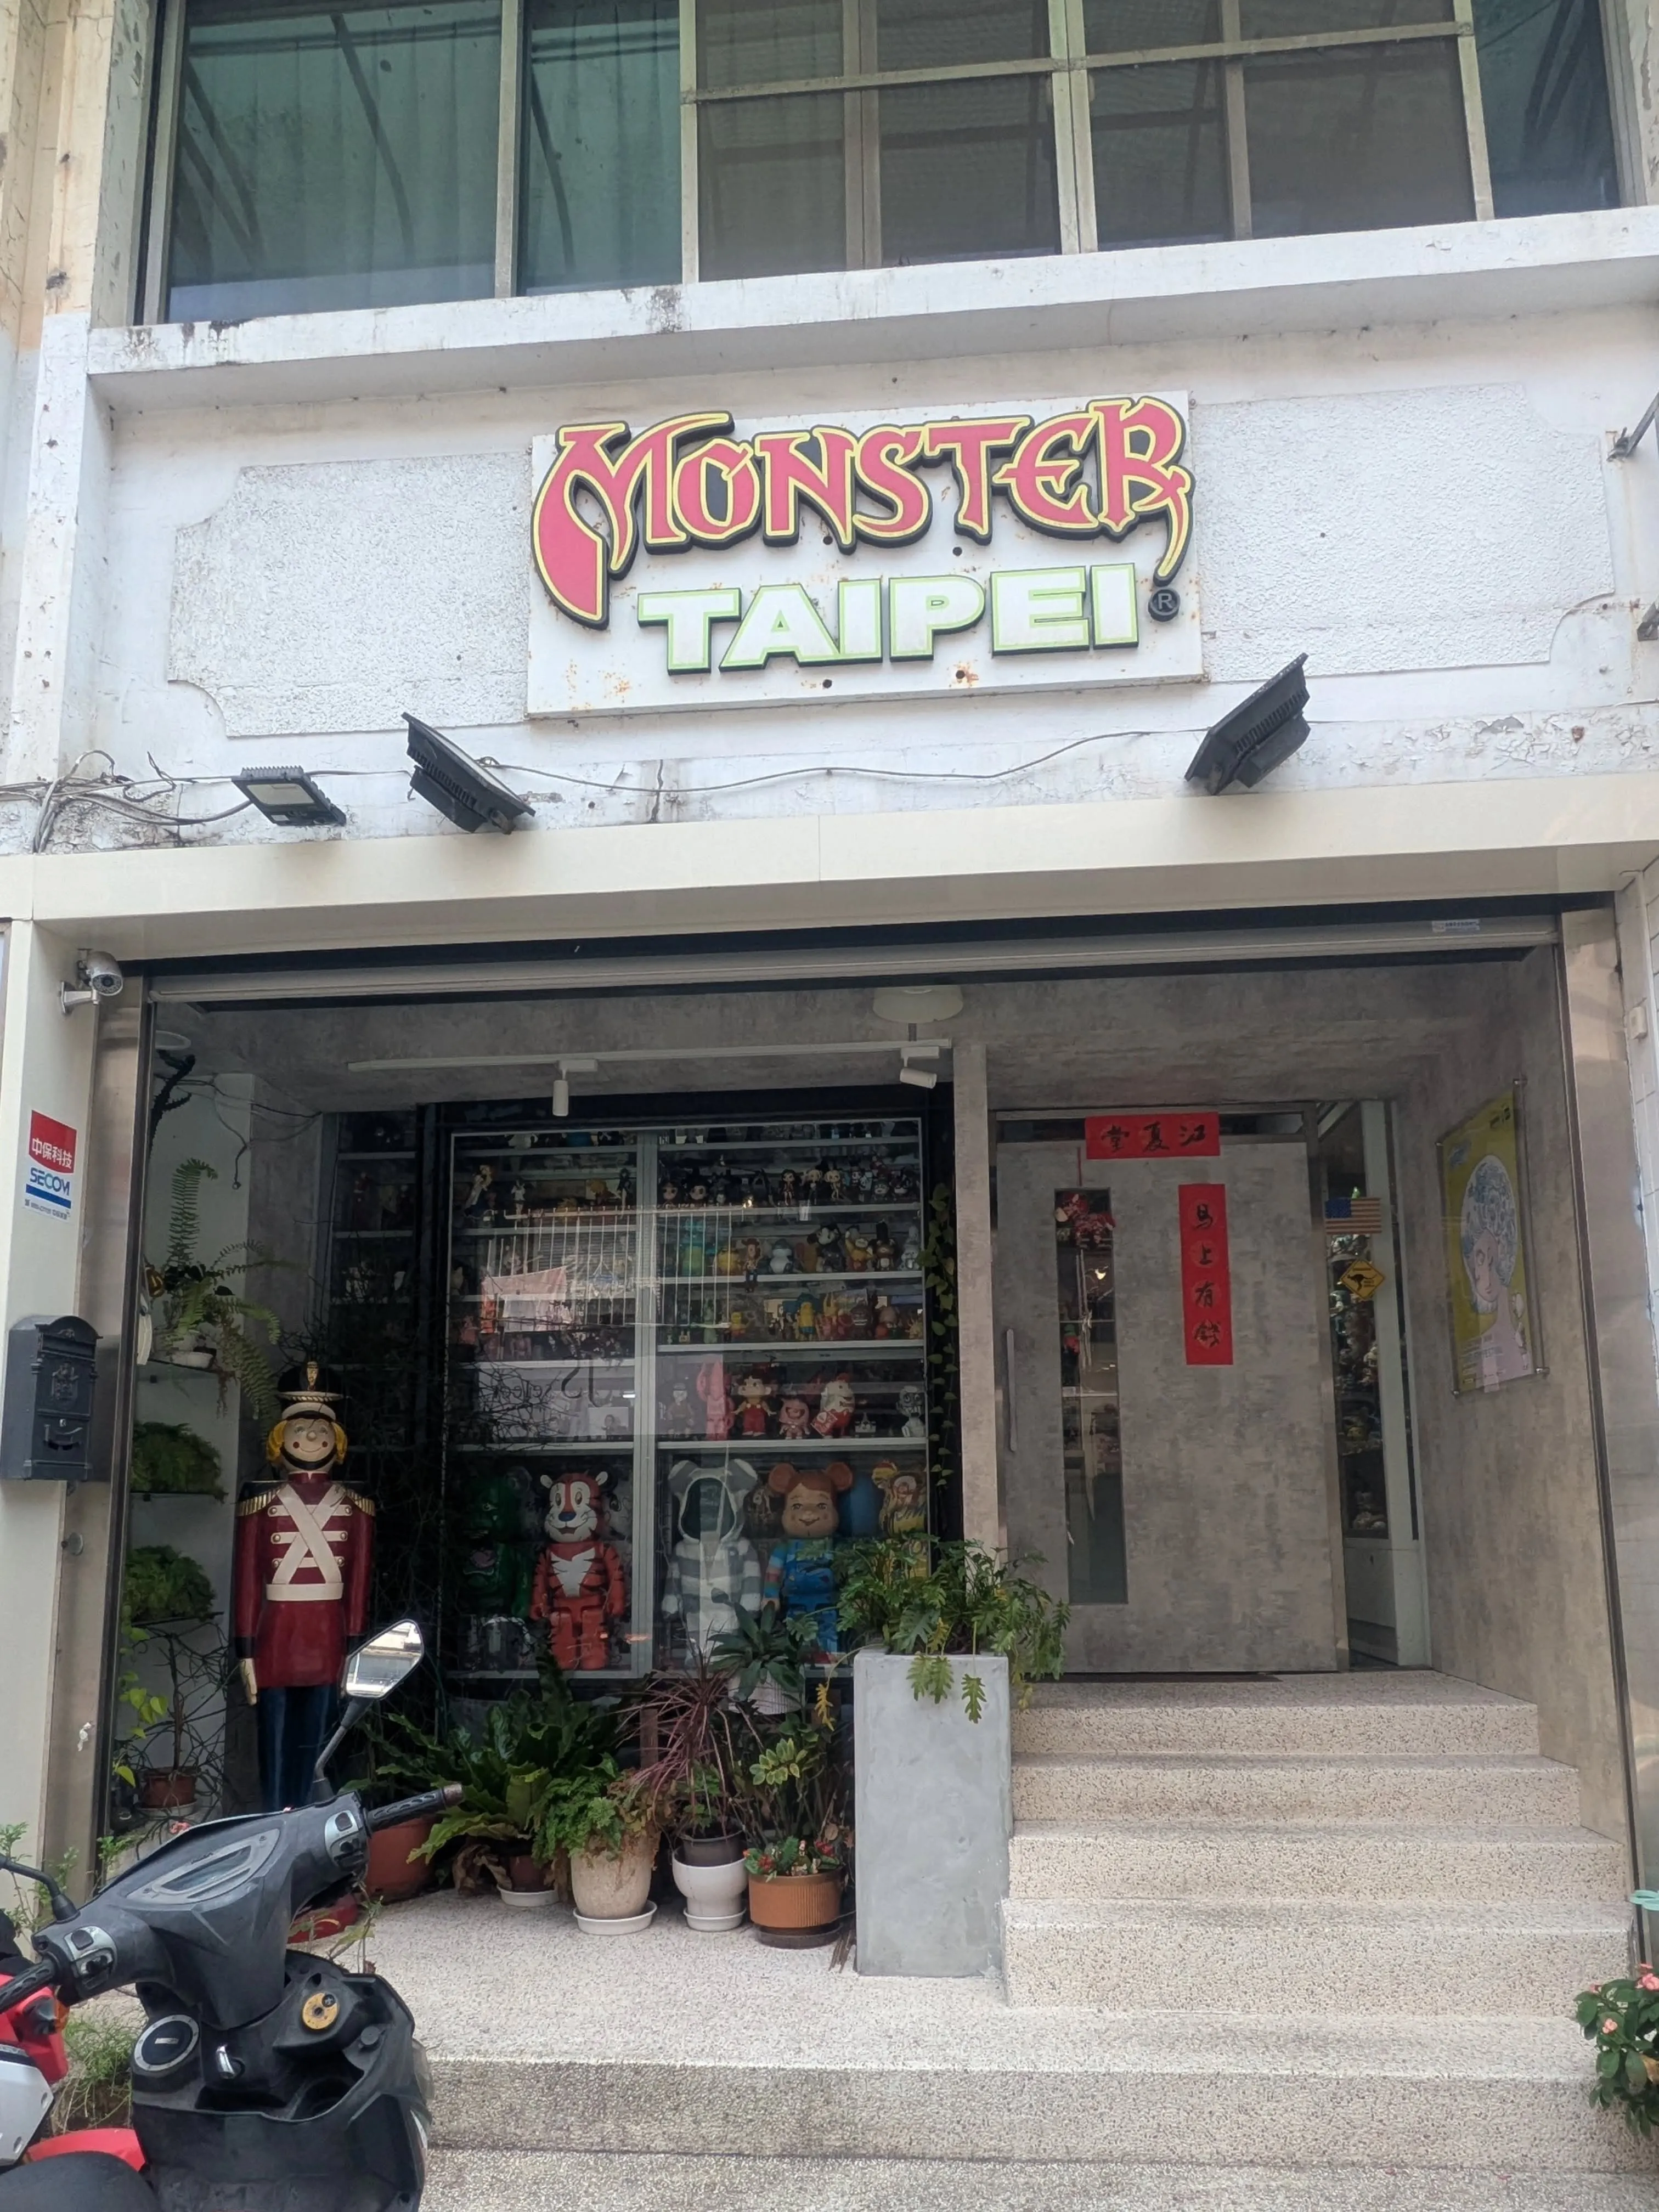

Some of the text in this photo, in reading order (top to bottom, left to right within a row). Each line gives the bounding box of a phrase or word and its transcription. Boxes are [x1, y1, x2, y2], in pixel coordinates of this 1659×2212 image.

[533, 396, 1195, 629] MONSTER
[637, 563, 1139, 675] TAIPEI
[30, 1167, 71, 1196] SECOM
[31, 1137, 73, 1169] 中保科技
